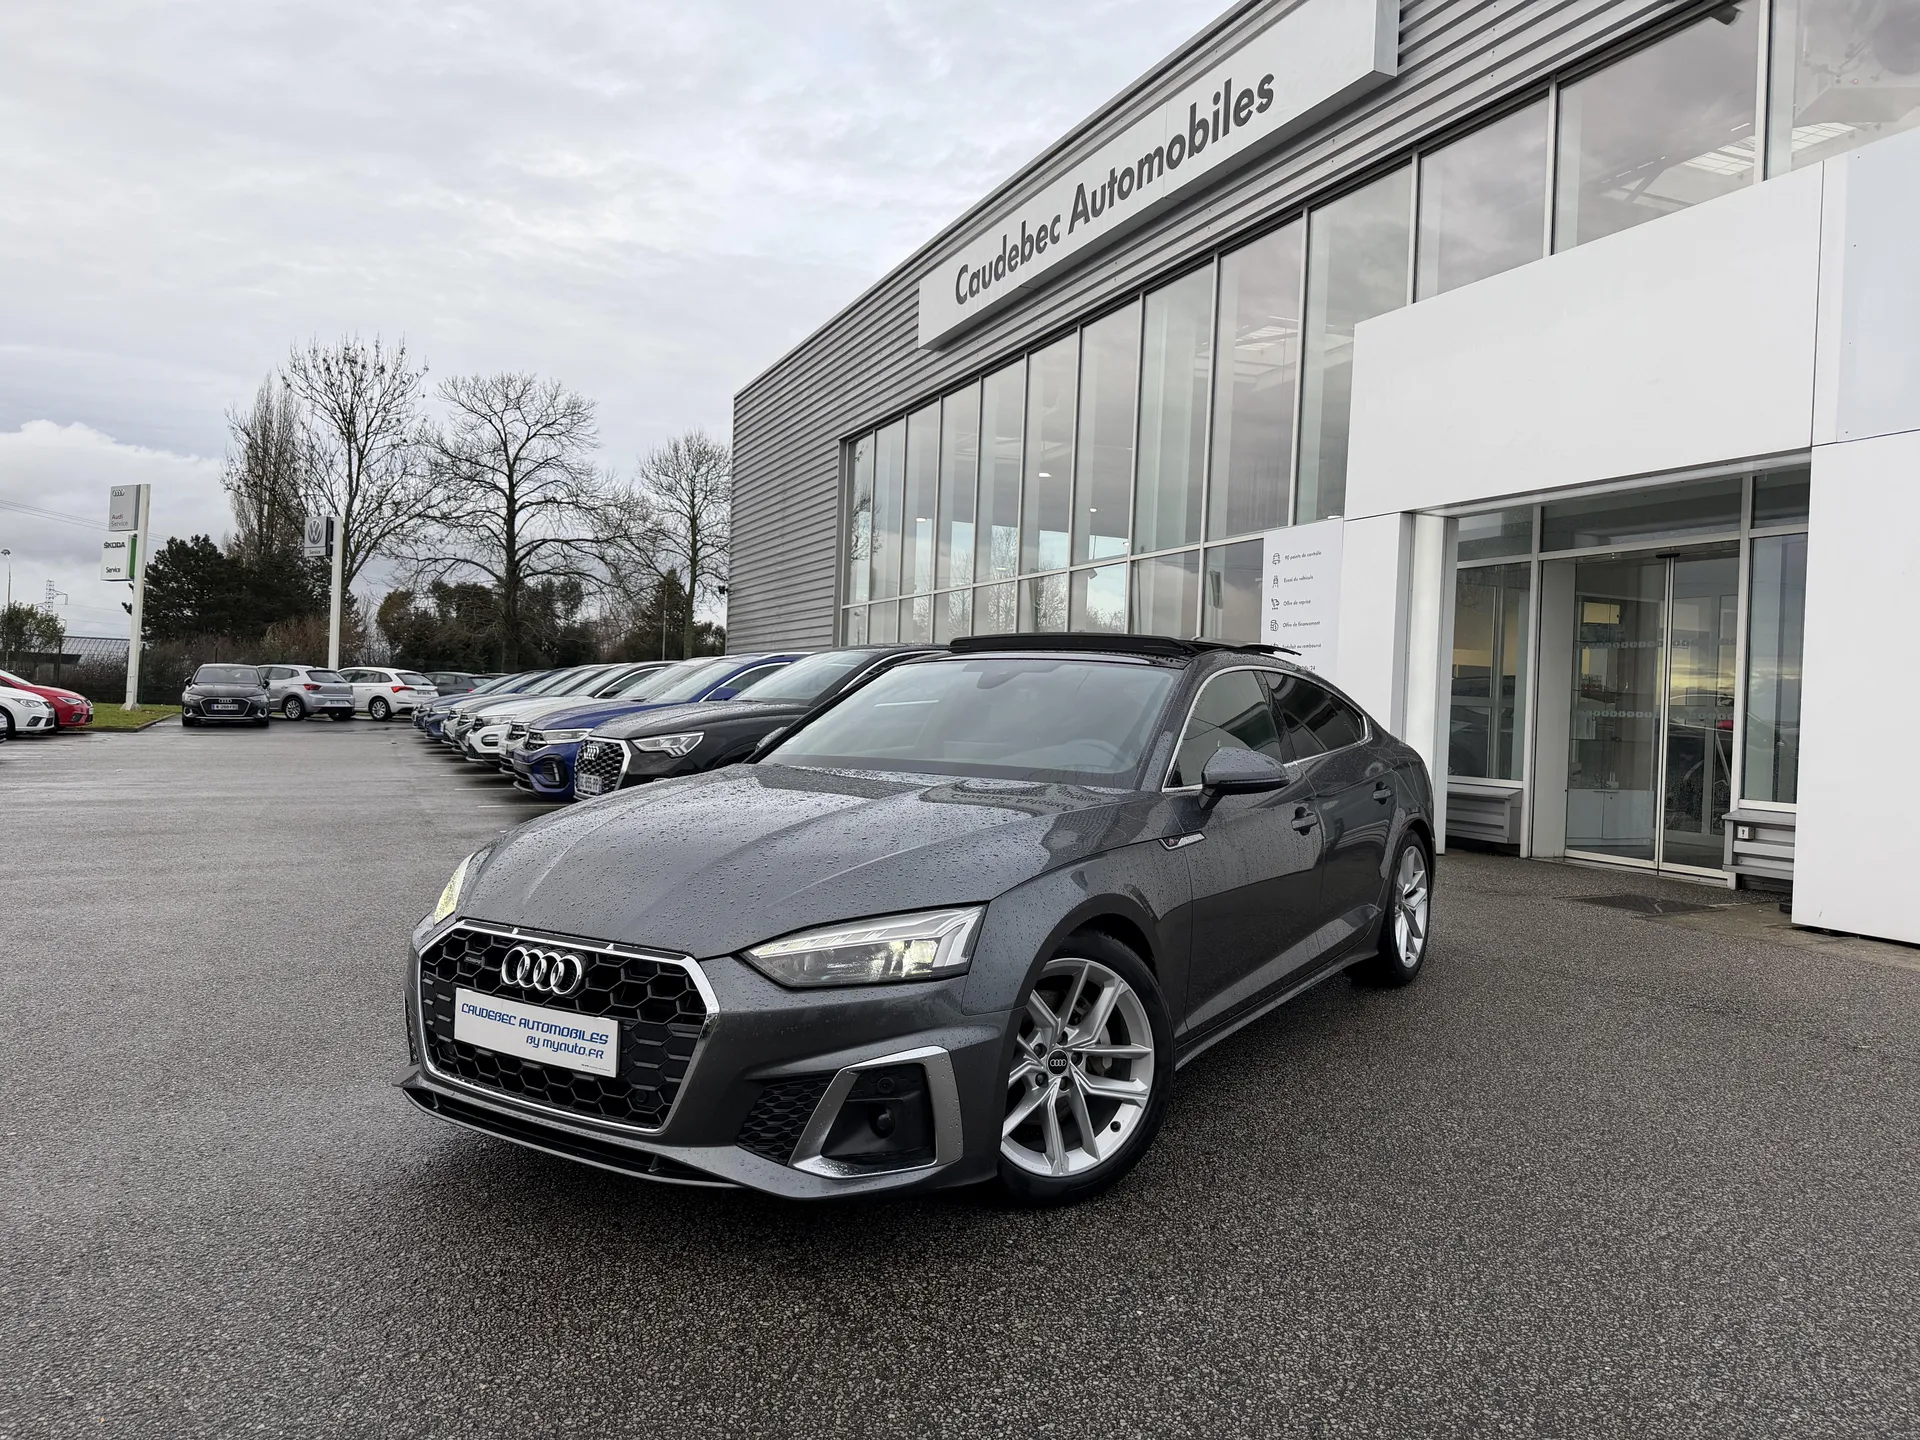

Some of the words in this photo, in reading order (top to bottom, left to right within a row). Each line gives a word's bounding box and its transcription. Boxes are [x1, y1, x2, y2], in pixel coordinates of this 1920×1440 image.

[955, 214, 1061, 305] Caudebec
[1068, 73, 1275, 236] Automobiles
[461, 1002, 517, 1026] CAUDEBEC
[518, 1017, 609, 1045] AUTOMOBILES
